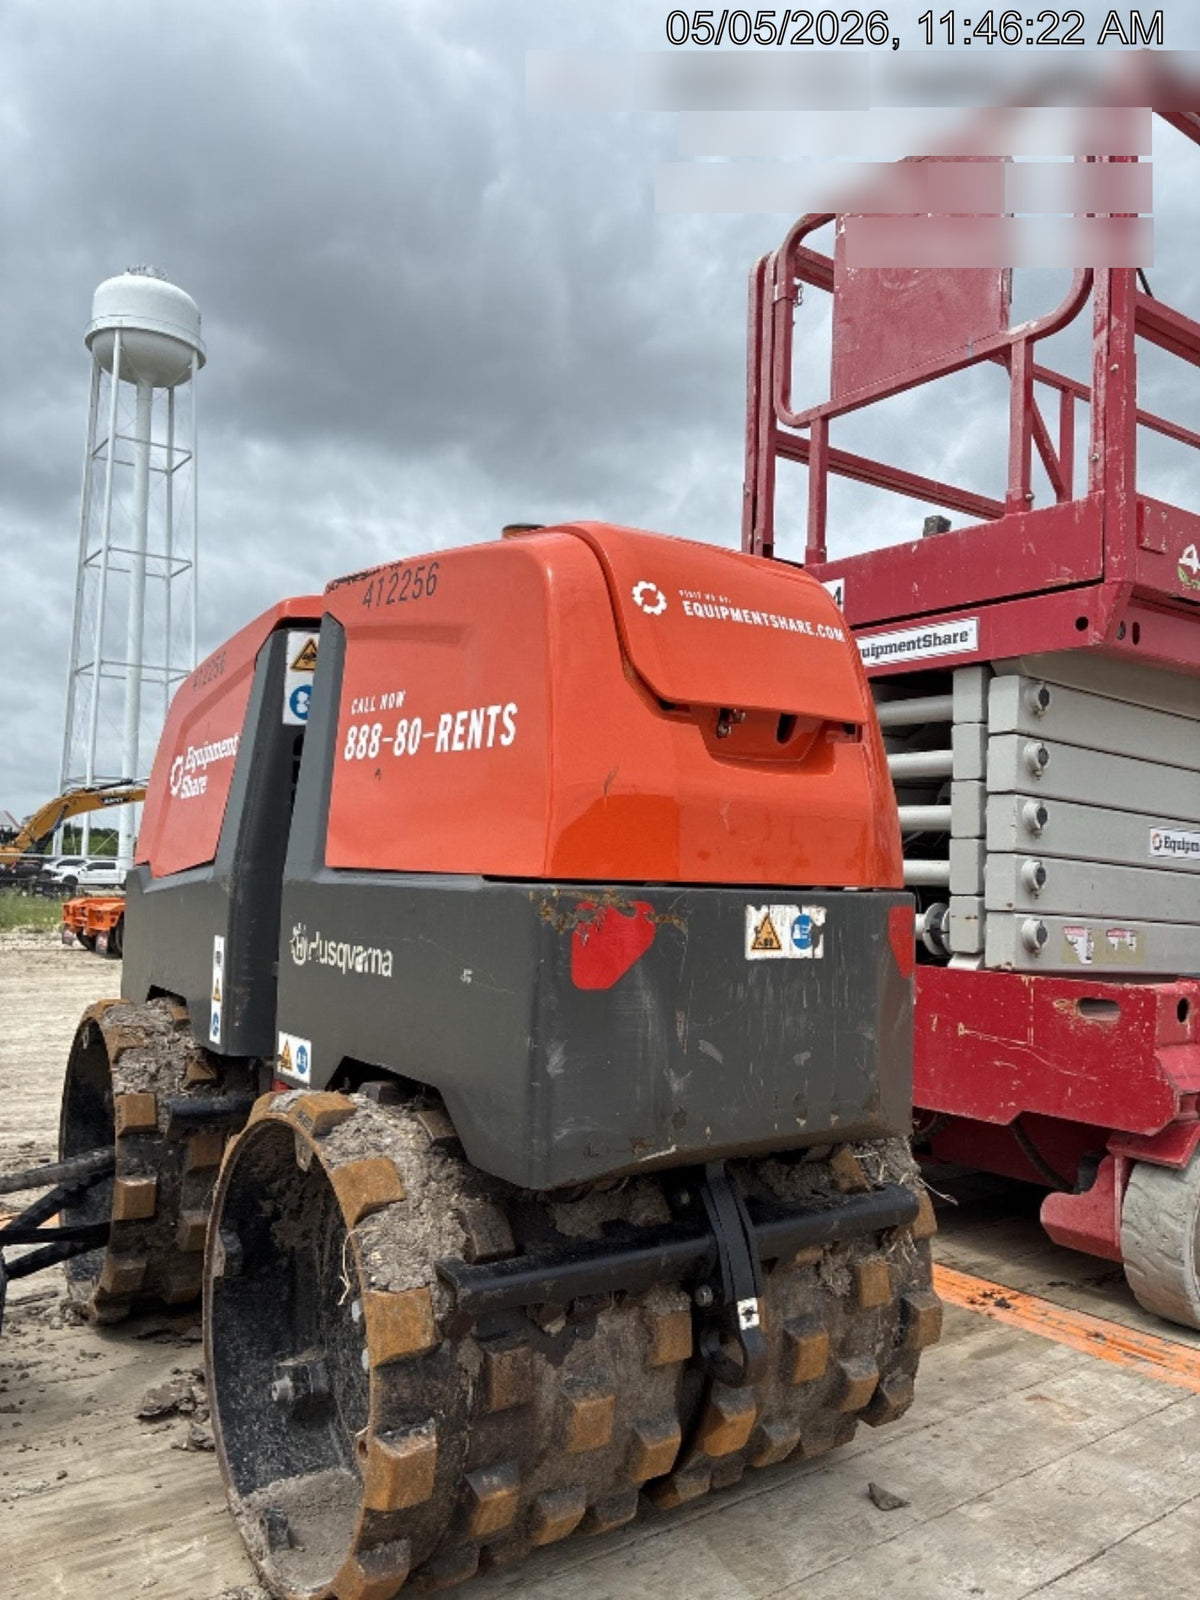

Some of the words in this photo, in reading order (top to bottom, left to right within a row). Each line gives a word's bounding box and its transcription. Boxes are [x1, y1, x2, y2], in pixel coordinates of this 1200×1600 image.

[682, 600, 846, 642] EQUIPMENTSHARE.COM
[861, 629, 969, 660] uipmentShare
[351, 696, 376, 715] CALL
[380, 690, 406, 710] NOW
[344, 702, 518, 761] 888-80-RENTS
[180, 775, 208, 800] Share
[1164, 835, 1200, 854] Equipm
